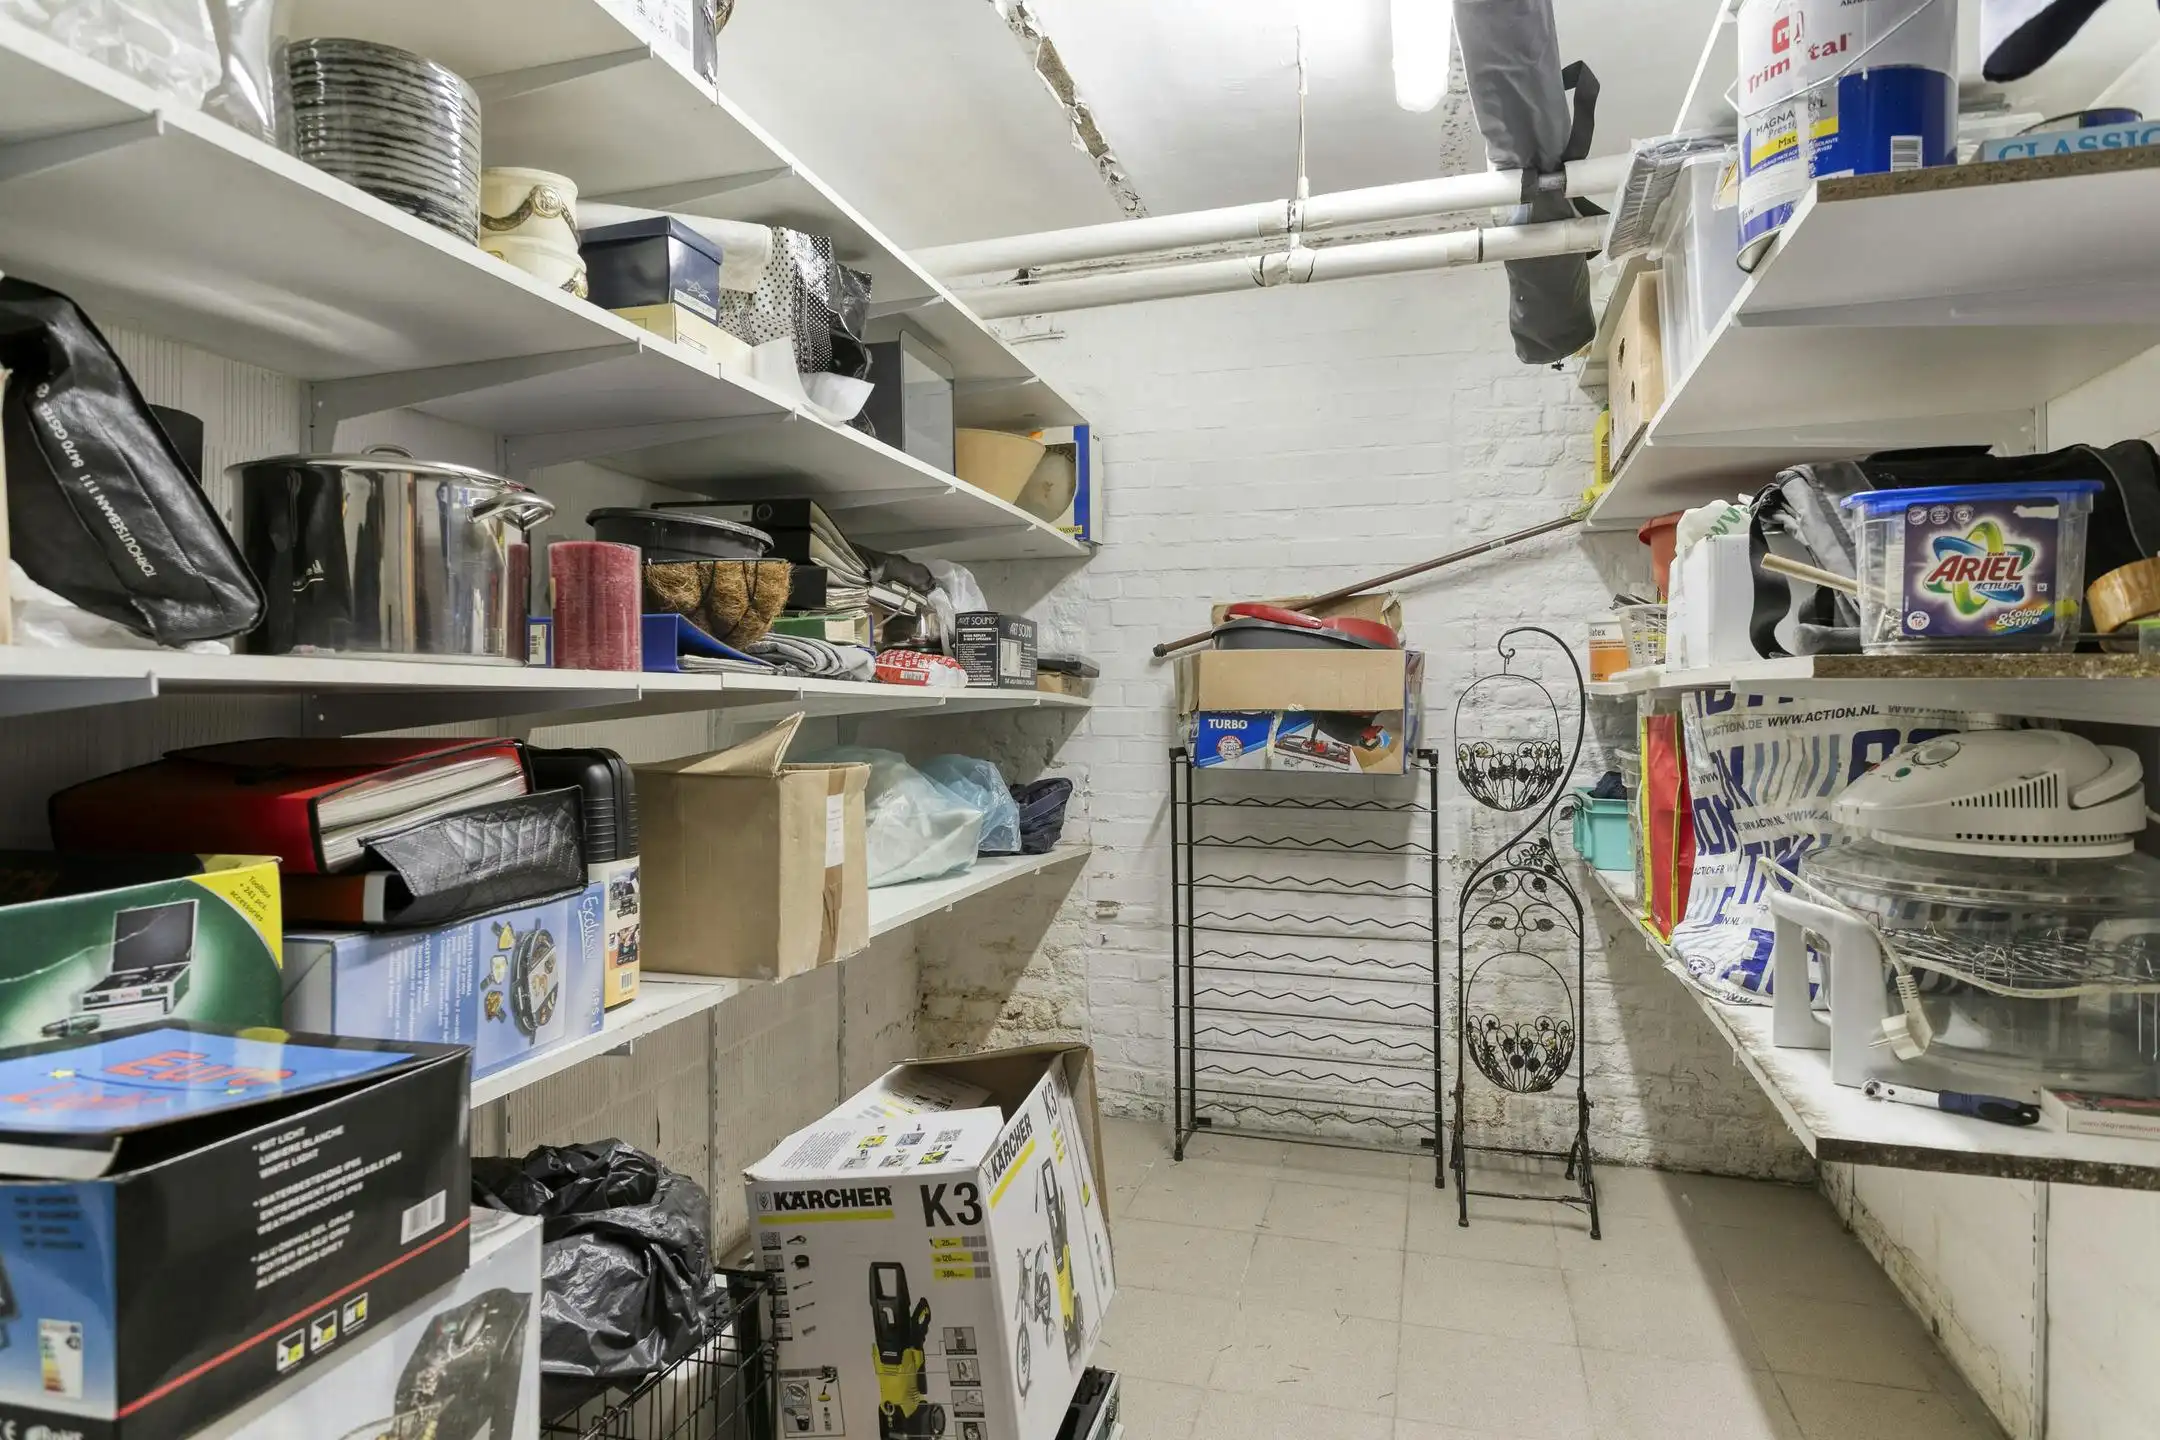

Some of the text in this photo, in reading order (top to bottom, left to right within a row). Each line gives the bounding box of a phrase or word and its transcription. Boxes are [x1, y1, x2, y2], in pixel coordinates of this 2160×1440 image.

[1747, 32, 1850, 95] Trimtal
[1778, 135, 1797, 148] Mat
[1928, 555, 2023, 582] ARIEL
[1973, 582, 2020, 592] ACTILIFT
[971, 616, 996, 626] SOUND
[2006, 615, 2040, 628] Style
[2008, 608, 2044, 618] Colour
[1208, 719, 1249, 729] TURBO
[1767, 704, 1880, 728] WWW.ACTION.NL
[1041, 1081, 1058, 1125] K3
[990, 1112, 1033, 1183] KÄRCHER
[774, 1187, 893, 1211] KÄRCHER
[919, 1182, 983, 1228] K3
